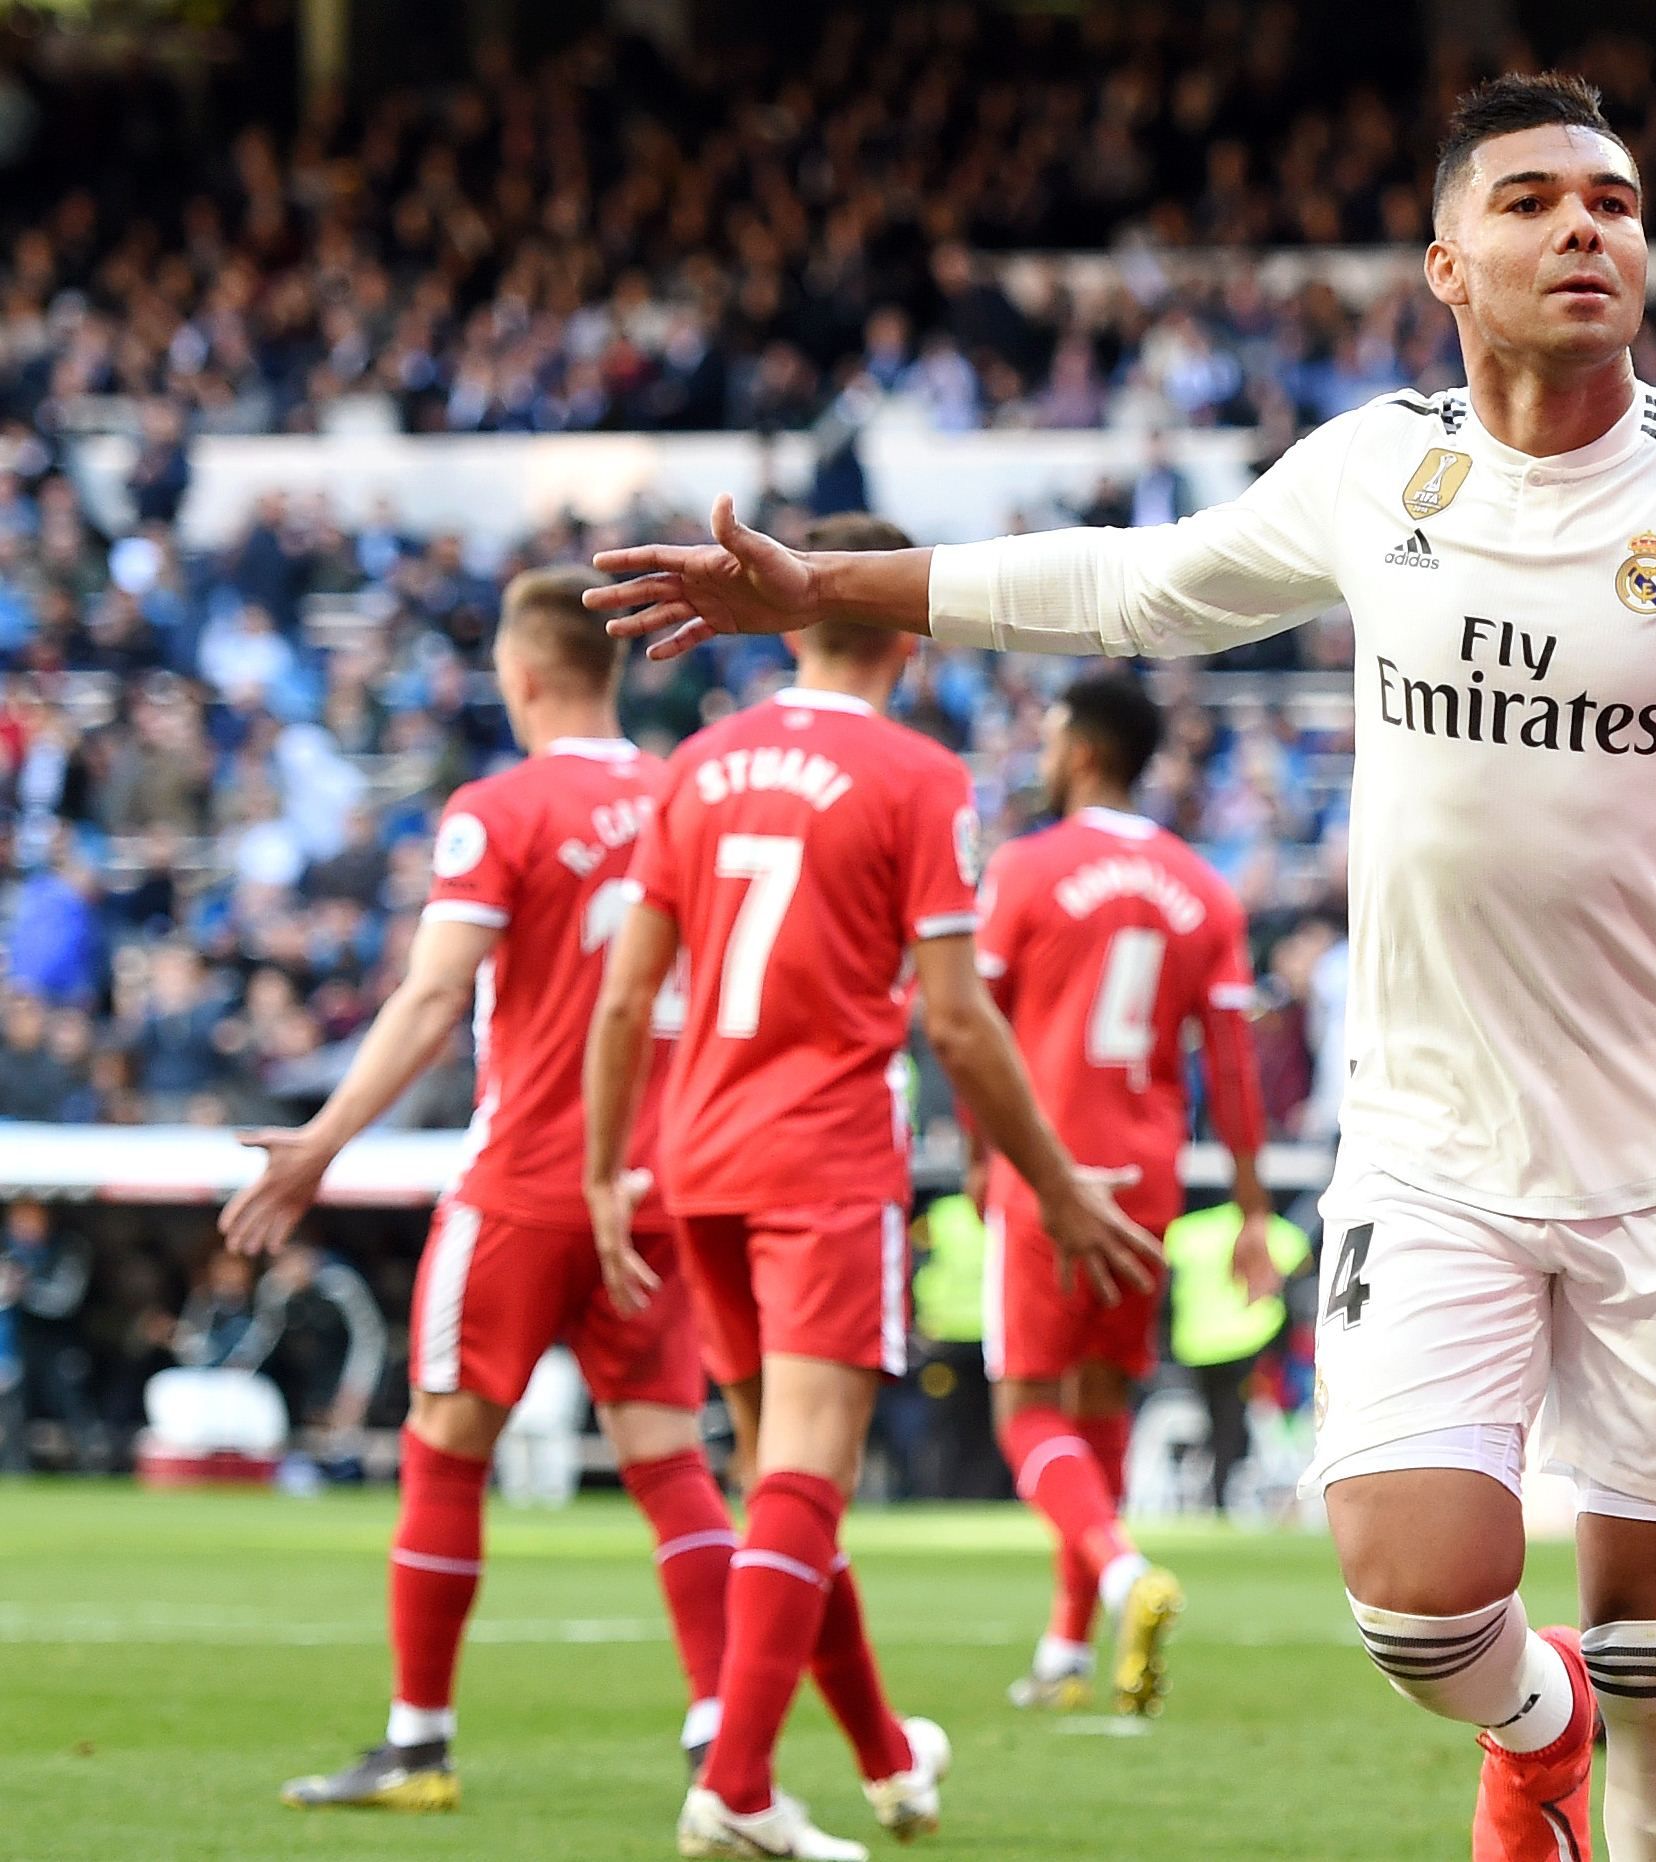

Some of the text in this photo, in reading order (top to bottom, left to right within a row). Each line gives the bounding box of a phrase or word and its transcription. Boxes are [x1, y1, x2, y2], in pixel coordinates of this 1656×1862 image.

[1413, 488, 1442, 505] FIFA
[1384, 551, 1440, 570] adidas
[1460, 615, 1557, 681] Fly
[716, 832, 804, 1039] 7
[1085, 926, 1168, 1093] 4
[1322, 1222, 1374, 1331] 4
